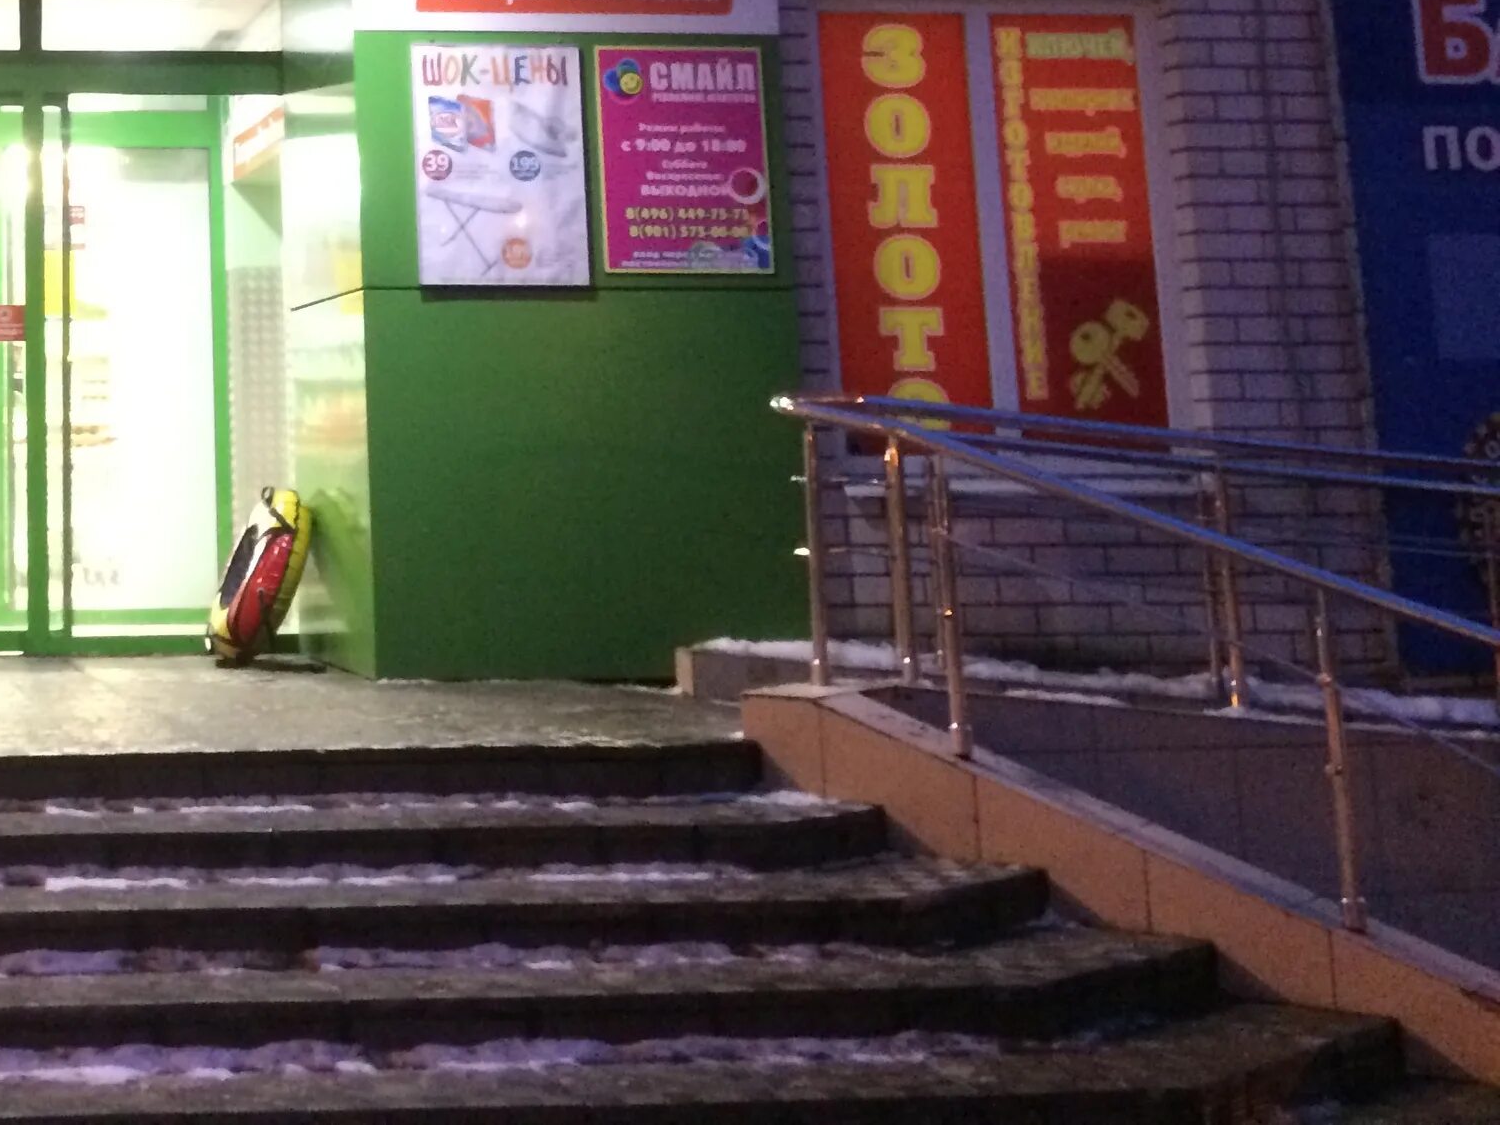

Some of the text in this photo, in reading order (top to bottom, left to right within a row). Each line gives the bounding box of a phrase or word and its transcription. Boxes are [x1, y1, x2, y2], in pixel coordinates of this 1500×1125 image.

[421, 52, 568, 94] ШОК-ЦЕНЫ
[650, 56, 756, 92] СМАЙЛ
[424, 153, 450, 172] 39
